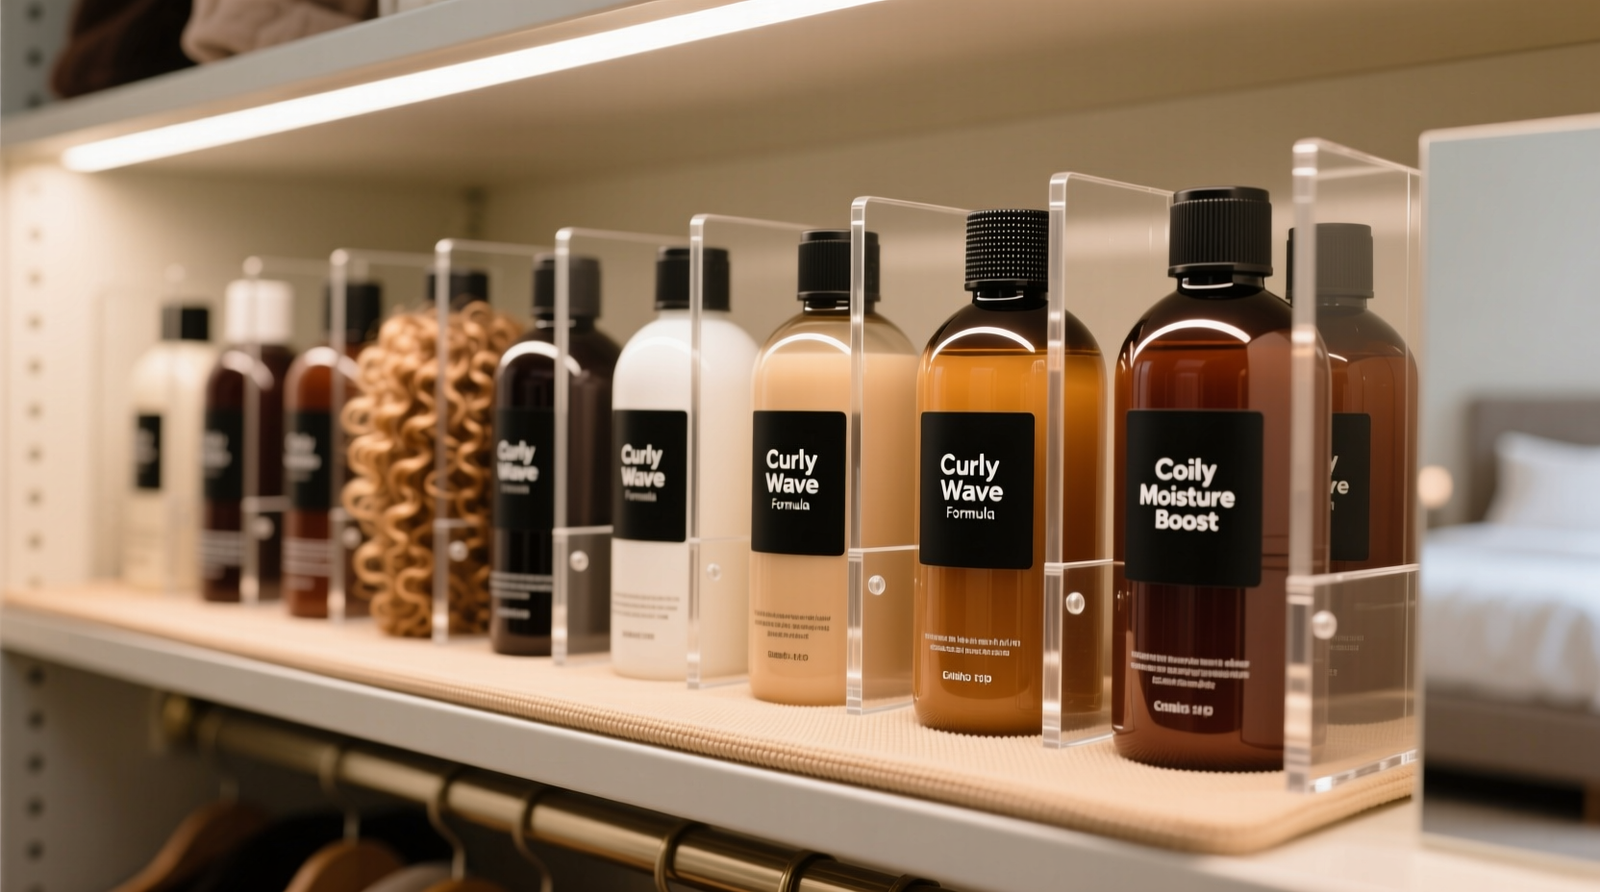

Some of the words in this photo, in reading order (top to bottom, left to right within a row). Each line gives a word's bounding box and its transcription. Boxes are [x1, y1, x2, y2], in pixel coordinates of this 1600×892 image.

[621, 444, 663, 470] Curly
[766, 449, 818, 476] Curly
[940, 453, 1000, 482] Curly
[620, 466, 666, 488] Wave
[765, 472, 819, 494] Wave
[1155, 457, 1218, 488] Coily
[940, 479, 1004, 502] Wave
[1139, 483, 1236, 509] Moisture
[946, 506, 995, 520] Formula
[1155, 508, 1220, 533] Boost
